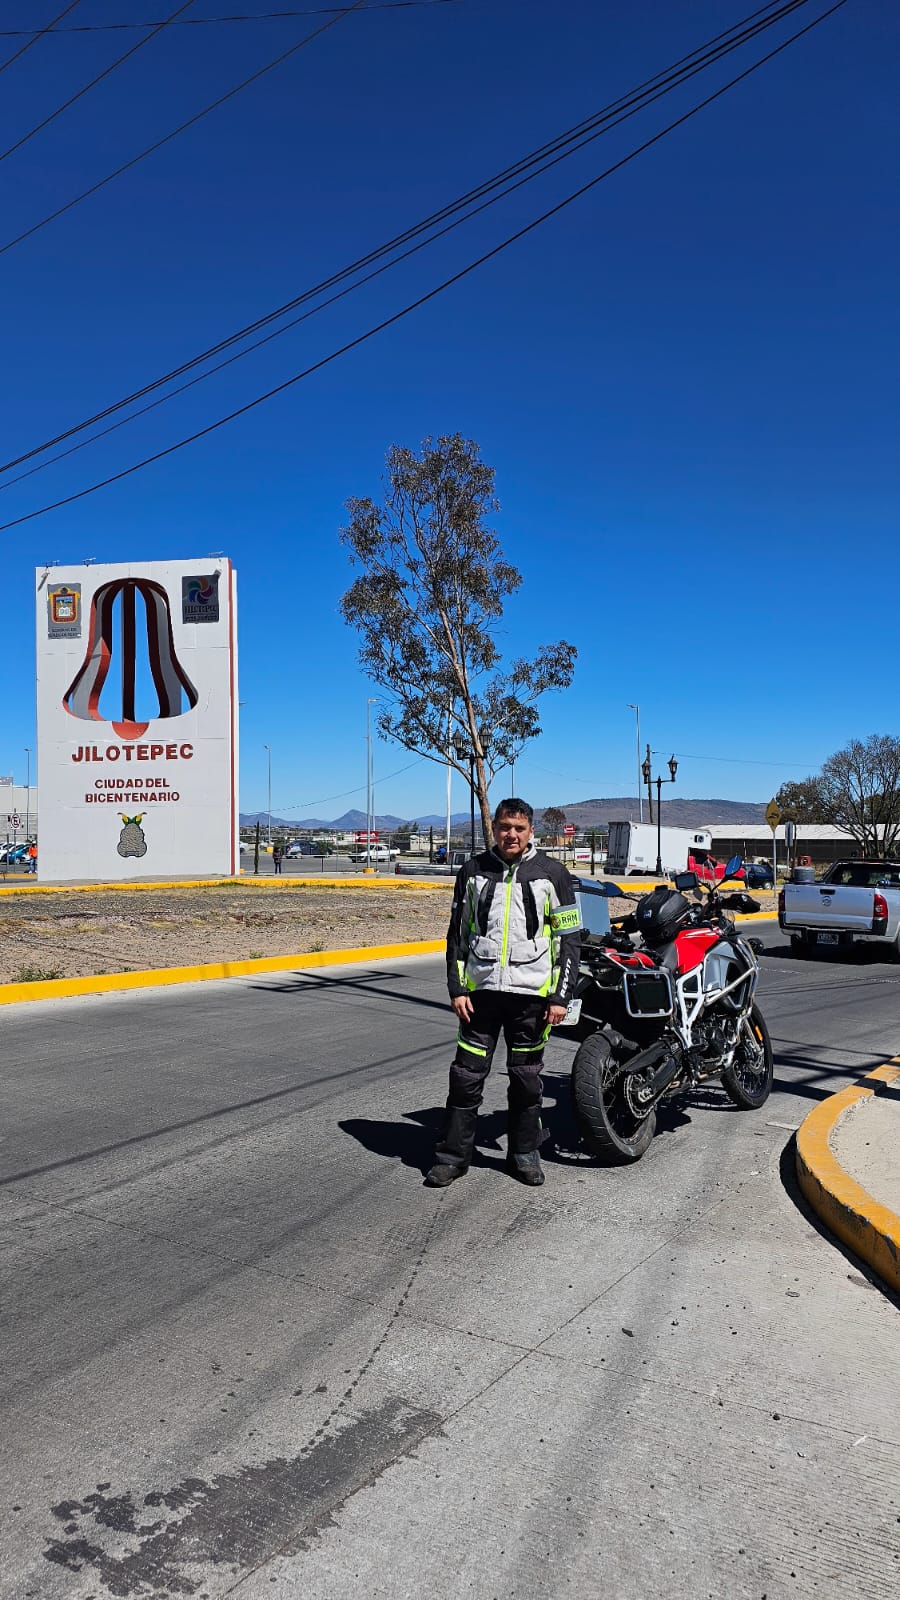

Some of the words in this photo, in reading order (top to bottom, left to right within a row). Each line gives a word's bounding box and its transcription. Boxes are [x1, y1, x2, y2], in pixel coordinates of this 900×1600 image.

[72, 744, 193, 762] JILOTEPEC
[94, 779, 143, 788] CIUDAD
[145, 778, 170, 787] DEL
[85, 792, 180, 803] BICENTENARIO
